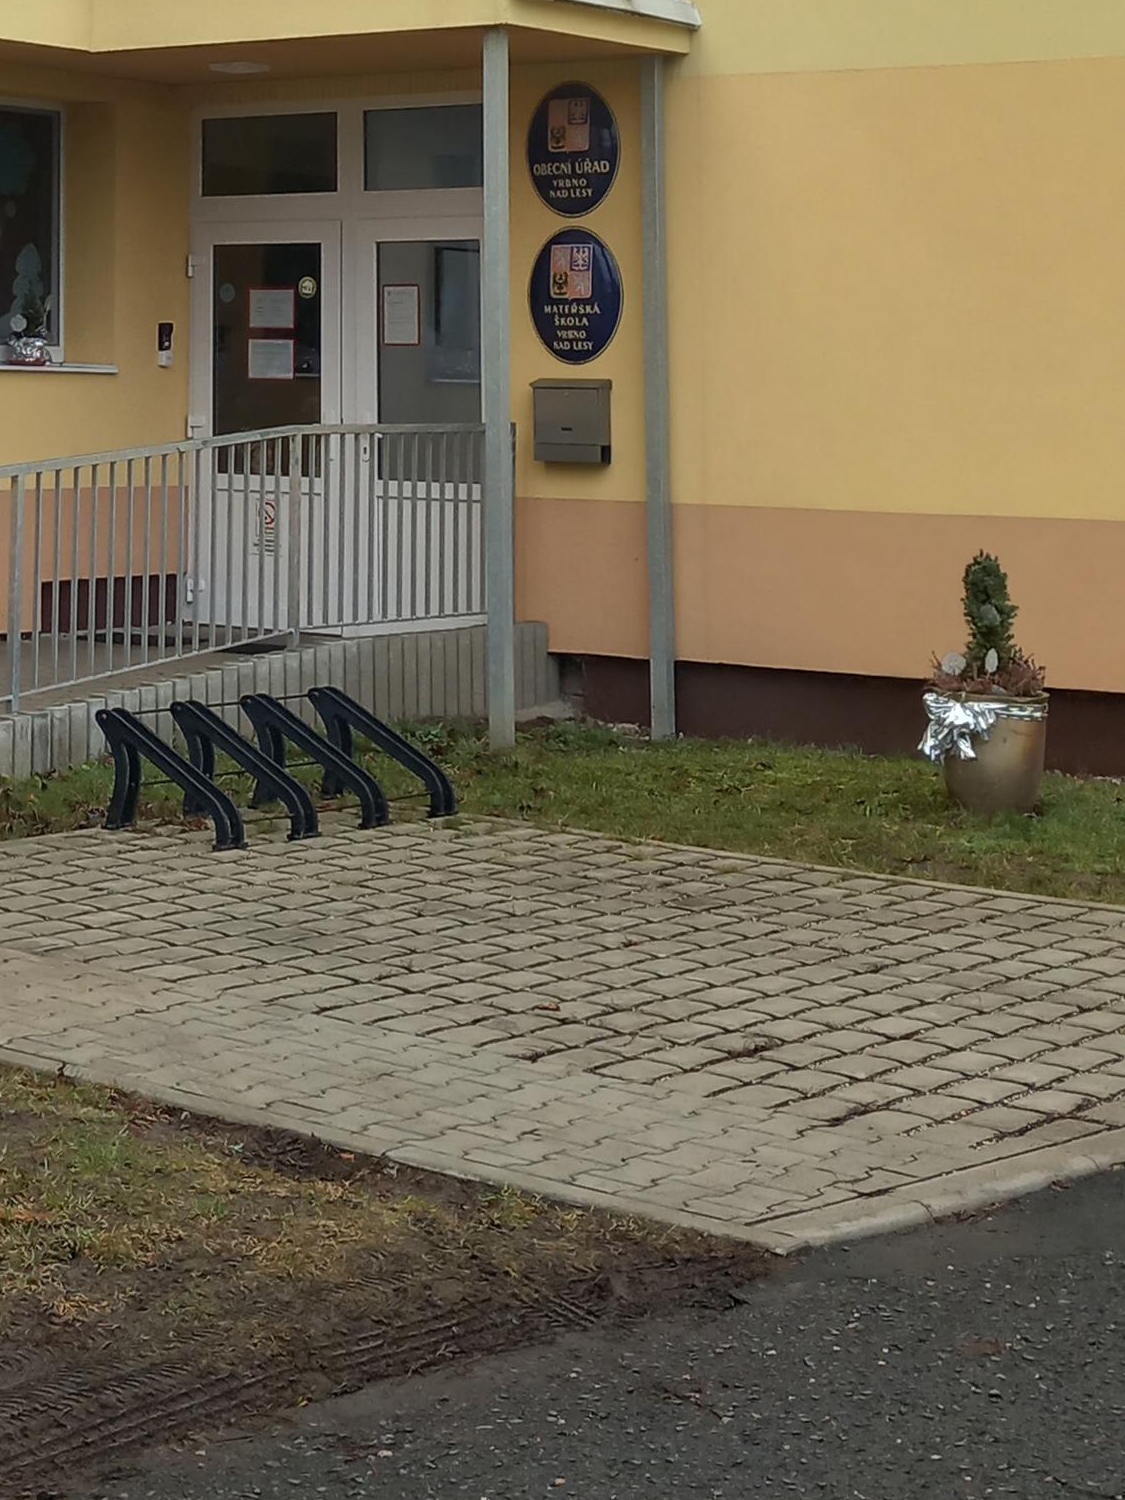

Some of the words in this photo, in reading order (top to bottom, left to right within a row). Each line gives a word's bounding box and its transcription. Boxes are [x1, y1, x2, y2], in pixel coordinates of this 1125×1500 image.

[533, 159, 573, 176] OBECNÍ
[575, 158, 611, 174] ÚŘAD
[553, 178, 588, 188] VRBNO
[549, 190, 569, 198] NAD
[570, 188, 593, 198] LESY
[544, 302, 602, 315] MATEŘSKÁ
[554, 314, 589, 327] ŠKOLA
[553, 341, 571, 350] NAD
[572, 341, 594, 351] LESY
